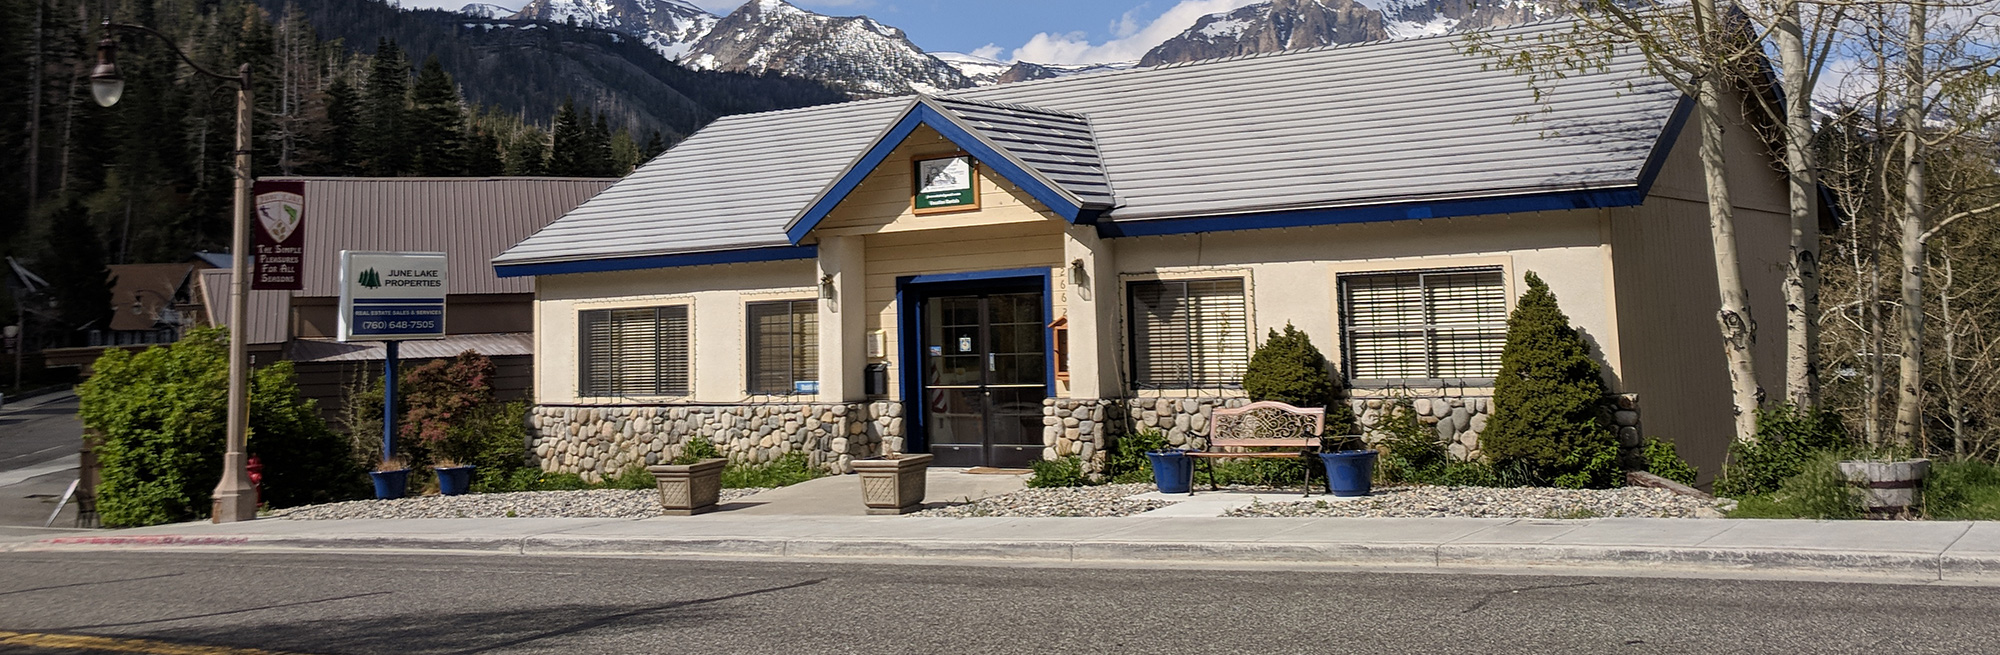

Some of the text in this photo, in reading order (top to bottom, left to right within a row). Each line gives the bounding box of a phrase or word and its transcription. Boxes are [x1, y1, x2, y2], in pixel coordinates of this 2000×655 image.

[388, 269, 439, 278] JUNE LAKE
[384, 279, 442, 288] PROPERTIES
[362, 320, 435, 330] (760) 648-7505
